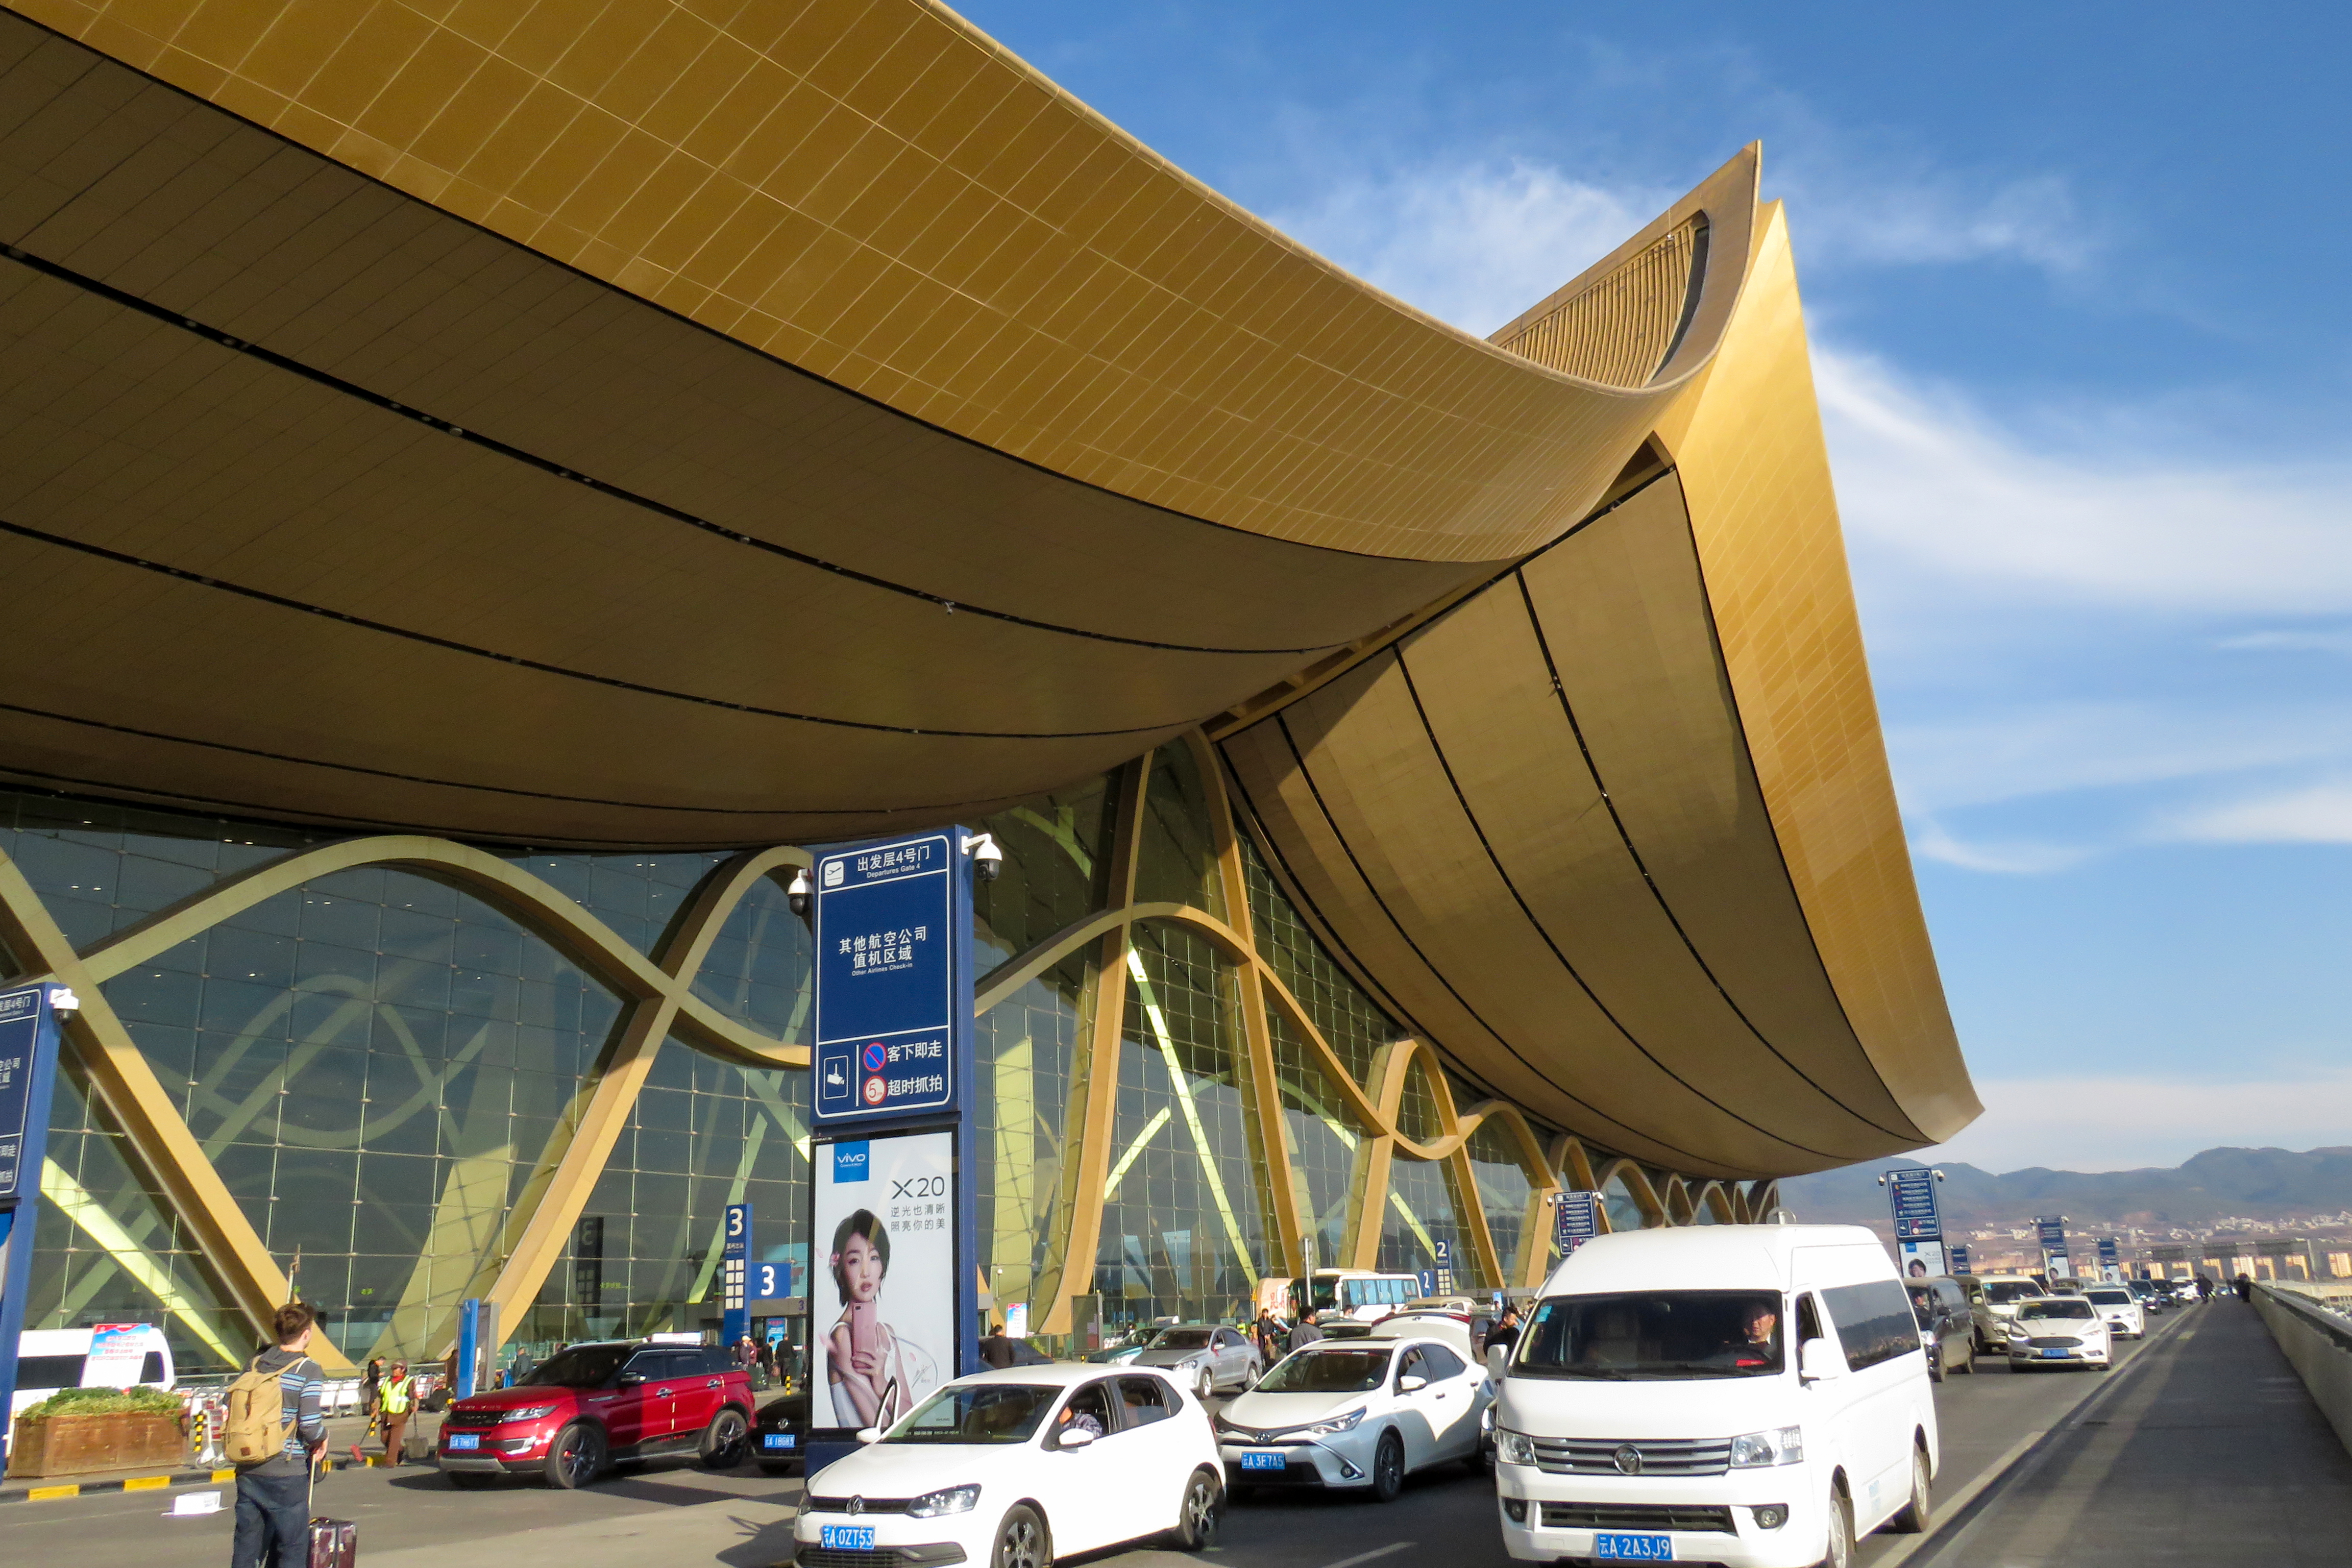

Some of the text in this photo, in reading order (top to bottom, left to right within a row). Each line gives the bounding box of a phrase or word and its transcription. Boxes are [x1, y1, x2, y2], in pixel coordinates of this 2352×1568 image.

[857, 845, 930, 872] 出发层4号门
[867, 869, 899, 878] Departures
[900, 865, 915, 873] Gate
[839, 925, 926, 954] 其他航空公司
[853, 945, 912, 969] 值机区域
[867, 966, 888, 974] Airlines
[889, 962, 913, 971] Check-in
[887, 1039, 942, 1063] 客下即走
[869, 1083, 876, 1098] 5
[887, 1073, 943, 1097] 超时抓拍
[837, 1153, 866, 1163] vivo
[891, 1175, 945, 1199] X20
[890, 1203, 945, 1218] 逆光也清晰
[728, 1208, 744, 1236] 3
[891, 1217, 945, 1233] 照亮你的美
[1436, 1241, 1448, 1257] 2
[761, 1265, 775, 1296] 3
[1423, 1271, 1430, 1289] 2
[798, 1300, 805, 1311] 3
